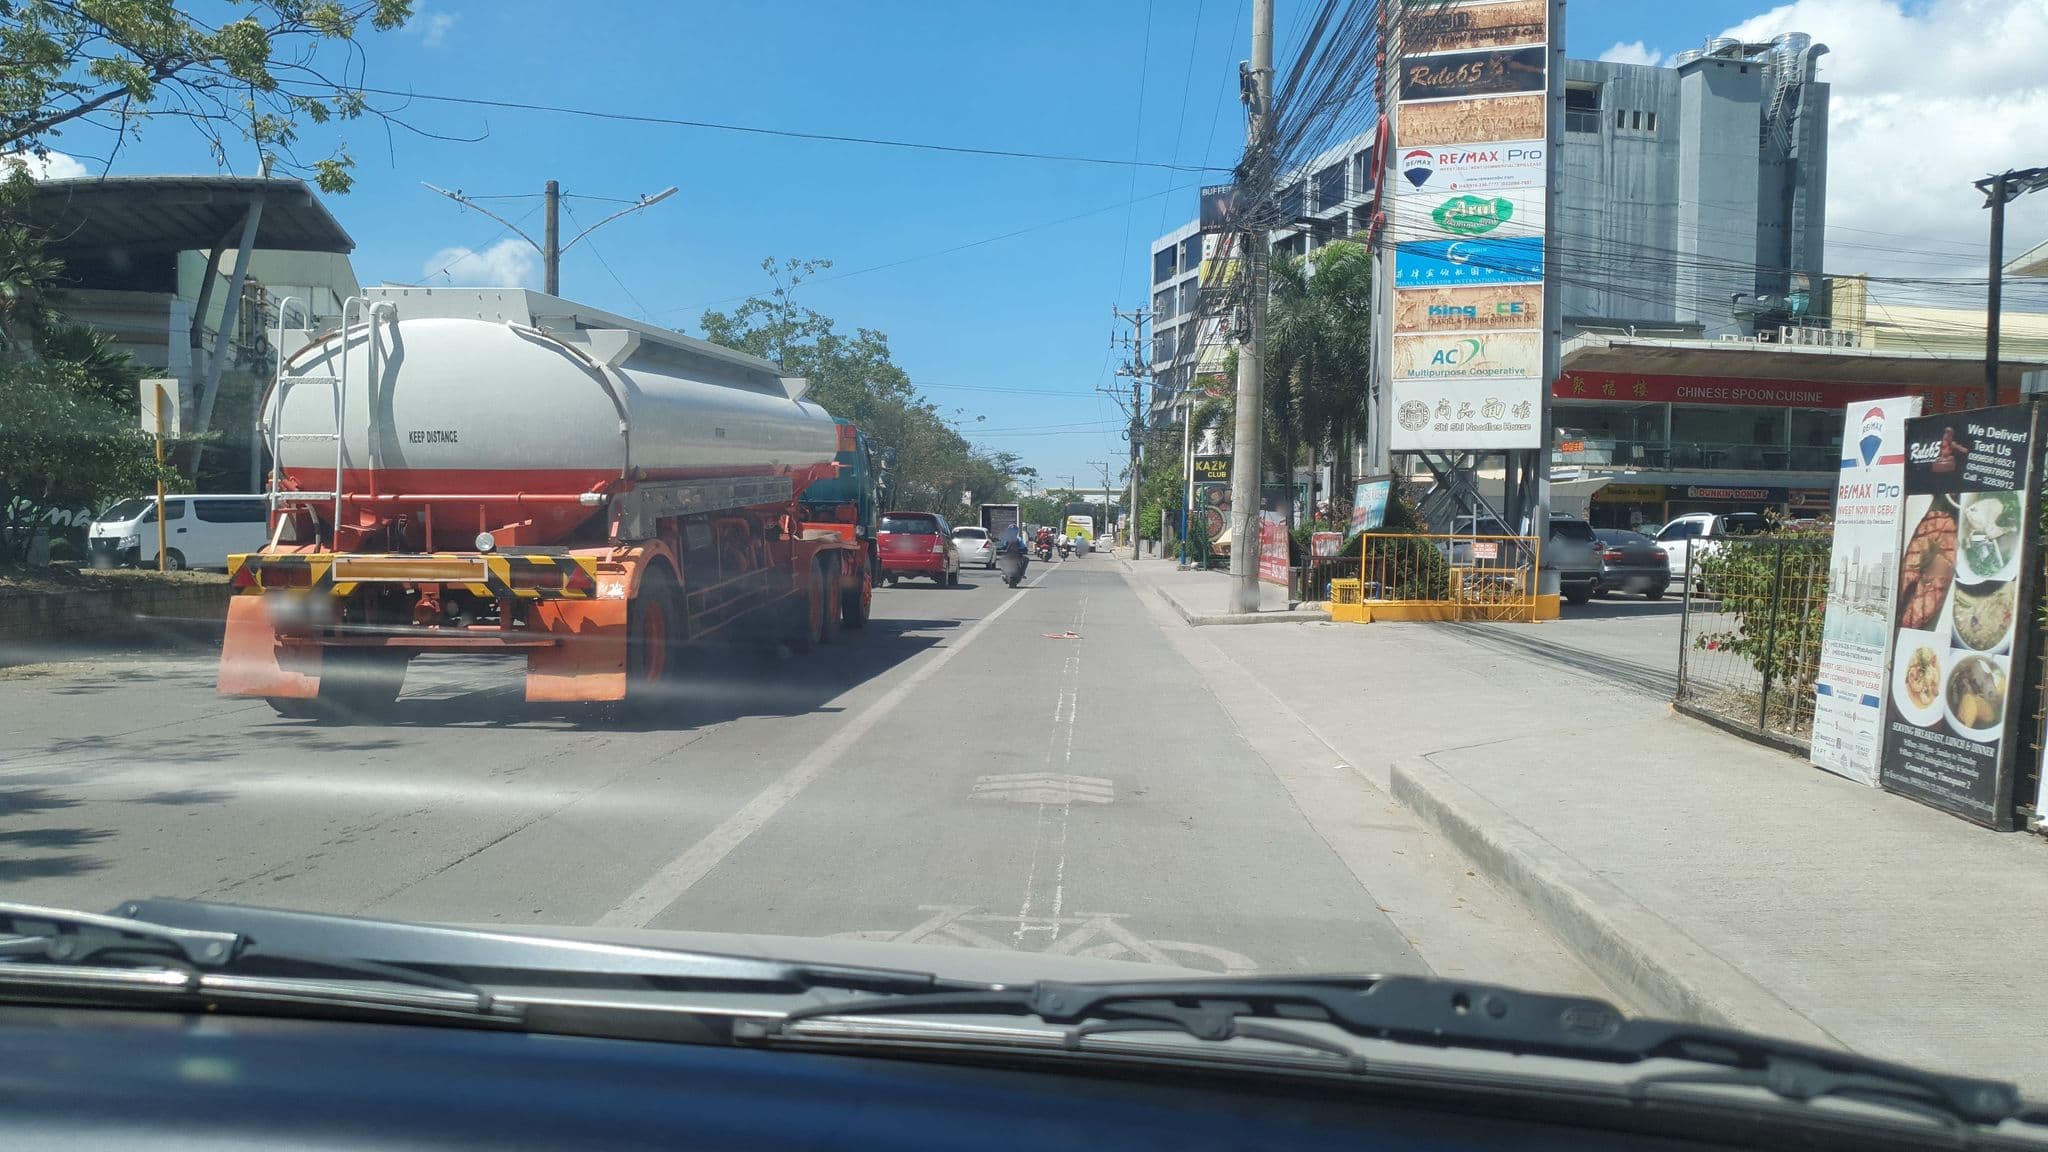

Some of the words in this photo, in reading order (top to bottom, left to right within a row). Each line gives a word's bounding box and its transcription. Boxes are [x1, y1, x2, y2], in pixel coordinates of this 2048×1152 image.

[1439, 151, 1499, 164] RE/MAX
[1507, 149, 1542, 160] Pro
[1407, 368, 1467, 378] Multipurpose
[1469, 366, 1526, 377] Cooperative
[1676, 386, 1730, 399] CHINESE
[1731, 388, 1774, 400] SPOON
[1775, 390, 1824, 403] CUISINE
[408, 430, 425, 443] KEEP
[427, 430, 458, 443] DISTANCE
[1968, 423, 1985, 436] We
[1986, 426, 2028, 443] Deliver!
[1974, 440, 1995, 453] Text
[1997, 444, 2012, 456] Us
[1839, 484, 1872, 499] RE/MAX
[1876, 482, 1900, 498] Pro
